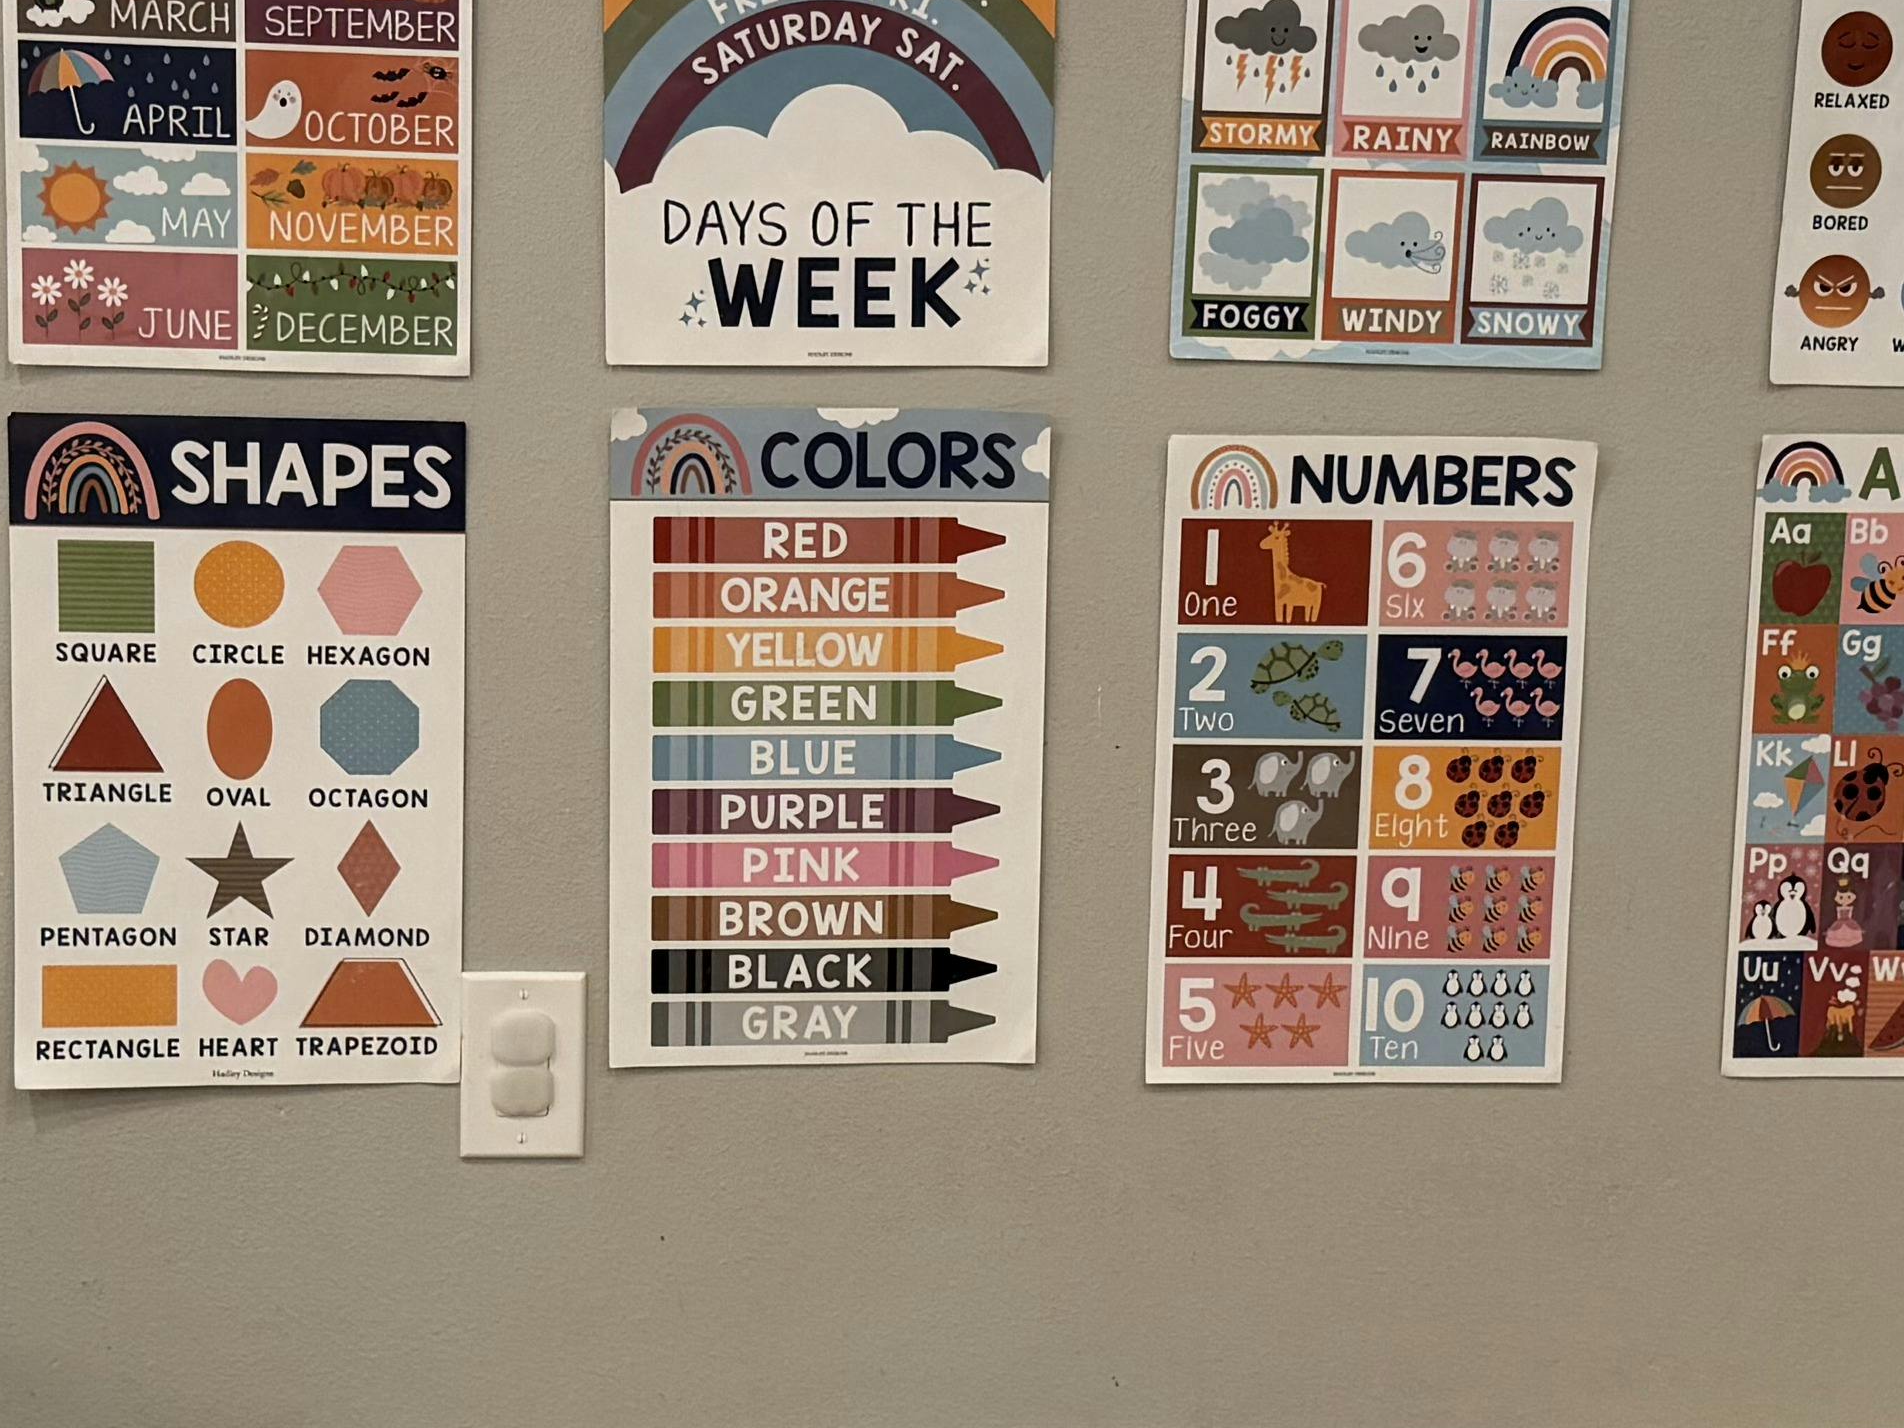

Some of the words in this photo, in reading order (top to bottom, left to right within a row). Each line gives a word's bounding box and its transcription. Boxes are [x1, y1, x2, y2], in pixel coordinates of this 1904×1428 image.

[265, 5, 455, 42] SEPTEMBER
[691, 11, 881, 86] SATURDAY
[895, 28, 965, 91] SAT.
[1814, 93, 1890, 110] RELAXED
[123, 105, 231, 138] APRIL
[304, 111, 454, 146] OCTOBER
[1209, 122, 1314, 147] STORMY
[1353, 125, 1453, 153] RAINY
[1491, 132, 1590, 152] RAINBOW
[161, 207, 231, 239] MAY
[269, 211, 453, 247] NOVEMBER
[664, 199, 786, 245] DAYS
[812, 201, 874, 247] OF
[897, 202, 991, 247] THE
[1812, 215, 1868, 231] BORED
[708, 257, 961, 328] WEEK
[138, 308, 232, 340] JUNE
[277, 312, 453, 346] DECEMBER
[1202, 303, 1300, 330] FOGGY
[1342, 307, 1443, 334] WINDY
[1477, 310, 1581, 336] SNOWY
[1800, 336, 1859, 353] ANGRY
[171, 440, 452, 509] SHAPES
[761, 431, 1016, 490] COLORS
[1290, 454, 1576, 508] NUMBERS
[763, 522, 848, 560] RED
[1770, 517, 1812, 545] Aa
[1205, 529, 1219, 586] 1
[1387, 532, 1427, 588] 6
[720, 577, 890, 613] ORANGE
[1184, 592, 1238, 617] One
[56, 643, 157, 663] SQUARE
[193, 644, 285, 665] CIRCLE
[307, 645, 430, 666] HEXAGON
[726, 632, 884, 668] YELLOW
[1188, 646, 1228, 702] 2
[1406, 647, 1442, 704] 7
[731, 685, 877, 721] GREEN
[1179, 706, 1234, 732] Two
[1379, 709, 1464, 735] Seven
[750, 739, 856, 775] BLUE
[43, 782, 172, 804] TRIANGLE
[206, 787, 271, 807] OVAL
[308, 788, 428, 808] OCTAGON
[1196, 758, 1234, 814] 3
[1395, 755, 1432, 811] 8
[720, 794, 884, 830] PURPLE
[1173, 818, 1257, 843] Three
[743, 847, 860, 883] PINK
[1181, 866, 1222, 921] 4
[1381, 866, 1422, 922] 9
[719, 900, 884, 937] BROWN
[40, 927, 176, 947] PENTAGON
[209, 927, 269, 946] STAR
[305, 927, 430, 947] DIAMOND
[1168, 925, 1233, 951] Four
[728, 953, 873, 990] BLACK
[1178, 977, 1215, 1032] 5
[1365, 977, 1425, 1033] 10
[741, 1005, 857, 1041] GRAY
[36, 1038, 180, 1061] RECTANGLE
[199, 1037, 278, 1057] HEART
[296, 1036, 438, 1057] TRAPEZOID
[1369, 1035, 1418, 1061] Ten
